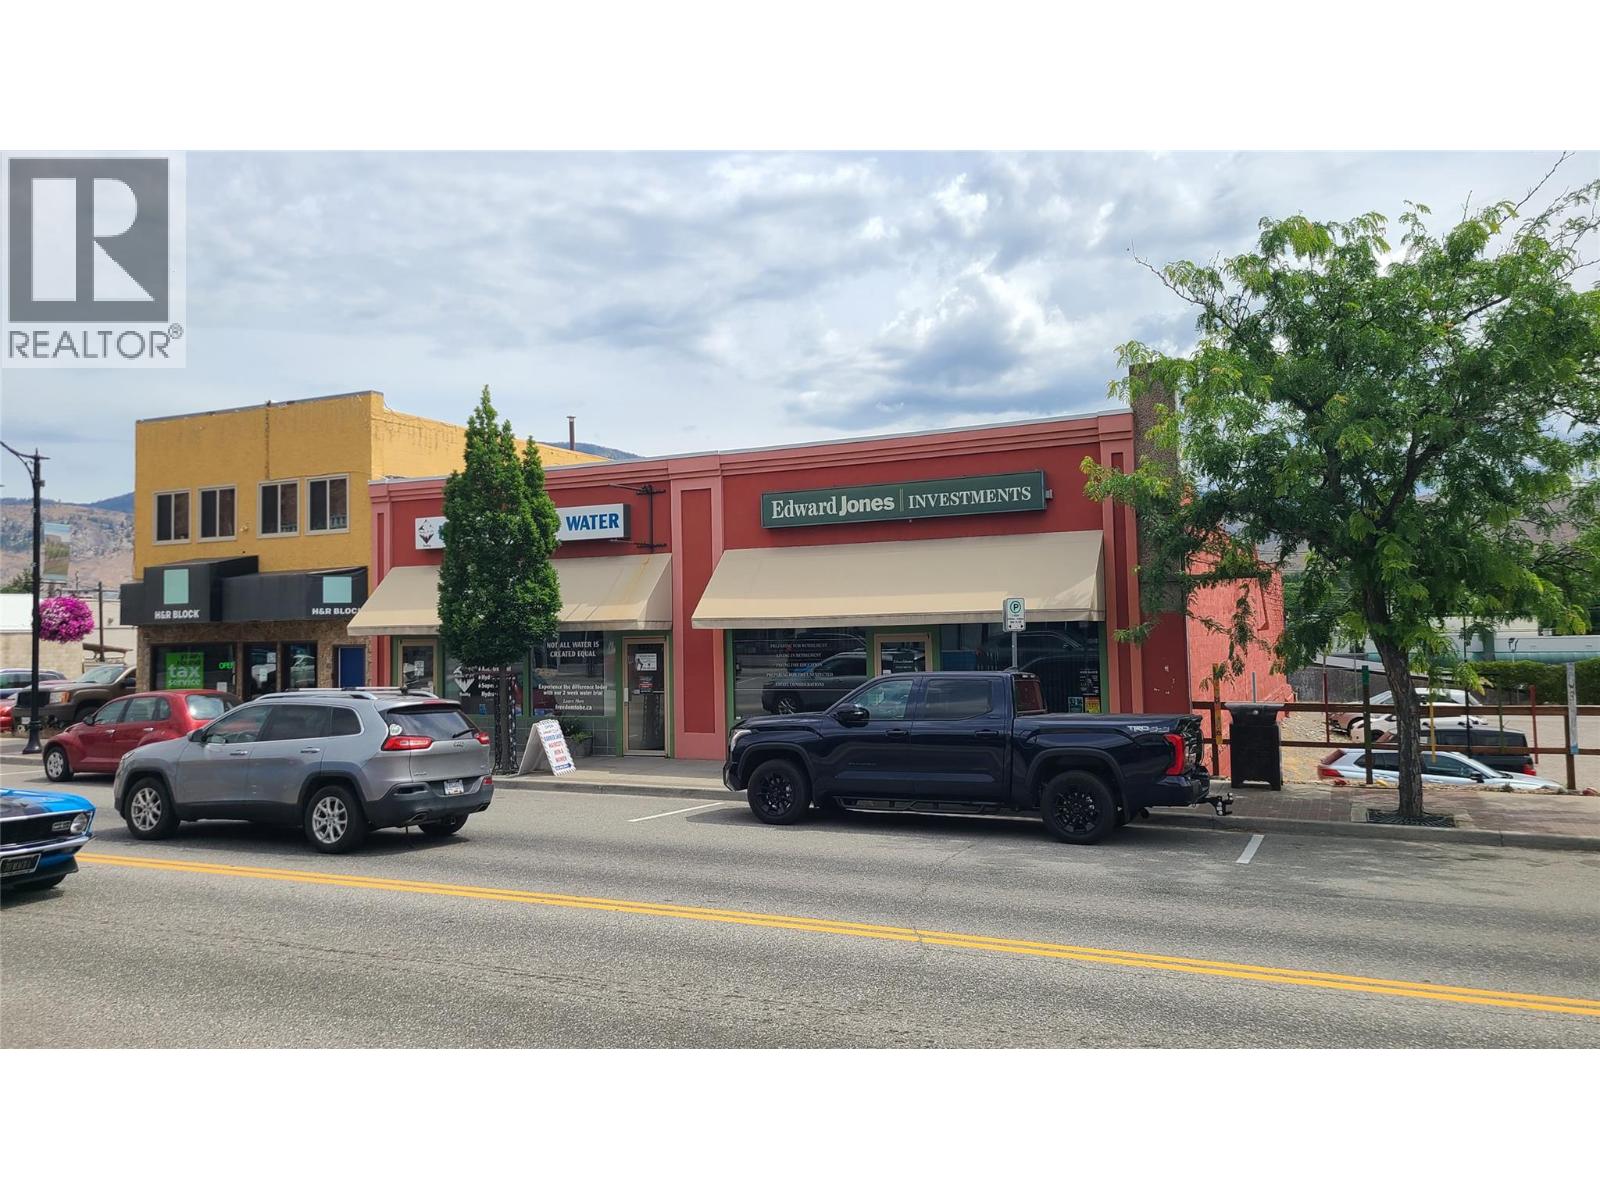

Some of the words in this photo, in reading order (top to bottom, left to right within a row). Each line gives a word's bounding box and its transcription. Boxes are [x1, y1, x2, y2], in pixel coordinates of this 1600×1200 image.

[908, 486, 1032, 509] INVESTMENTS
[566, 513, 619, 531] WATER
[154, 611, 171, 620] H&R
[172, 609, 200, 619] BLOCK
[311, 607, 332, 615] H&R
[333, 607, 362, 615] BLOC
[546, 641, 559, 649] NOT
[560, 641, 571, 649] ALL
[593, 640, 600, 648] IS
[550, 650, 576, 658] CREATED
[577, 650, 597, 658] EQUAL
[168, 664, 200, 678] tax
